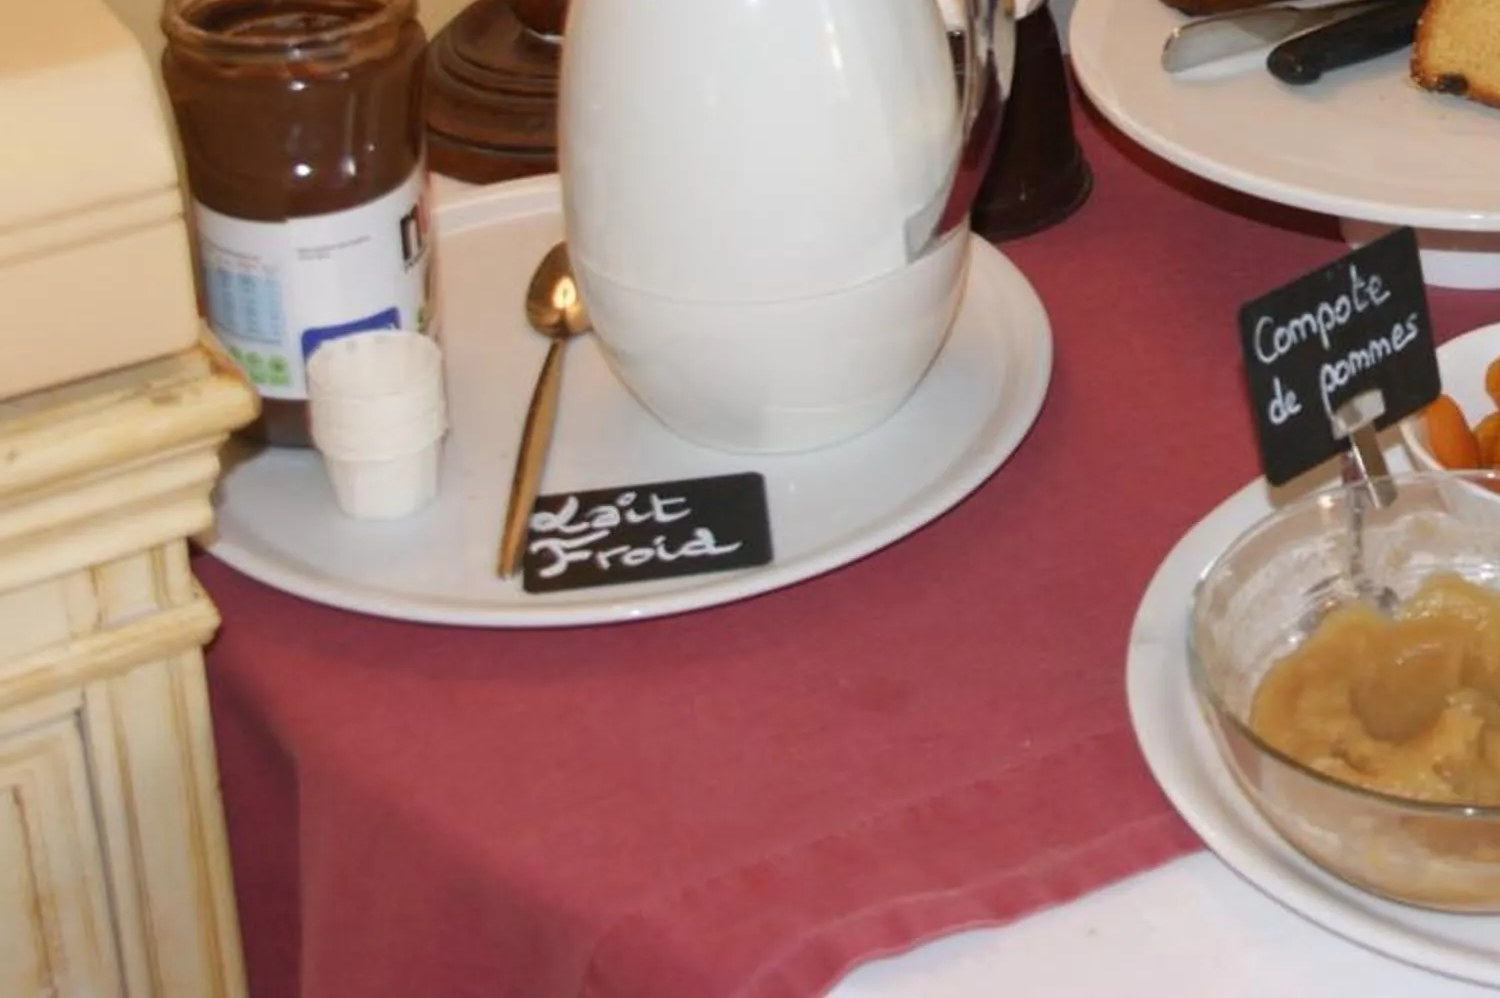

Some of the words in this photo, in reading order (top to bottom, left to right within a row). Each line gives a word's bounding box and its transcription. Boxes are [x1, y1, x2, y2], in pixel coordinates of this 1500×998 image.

[1255, 264, 1390, 364] Compote
[1269, 376, 1302, 424] de
[1320, 313, 1418, 420] pommes
[530, 491, 691, 534] Lait
[530, 527, 742, 578] Froid
